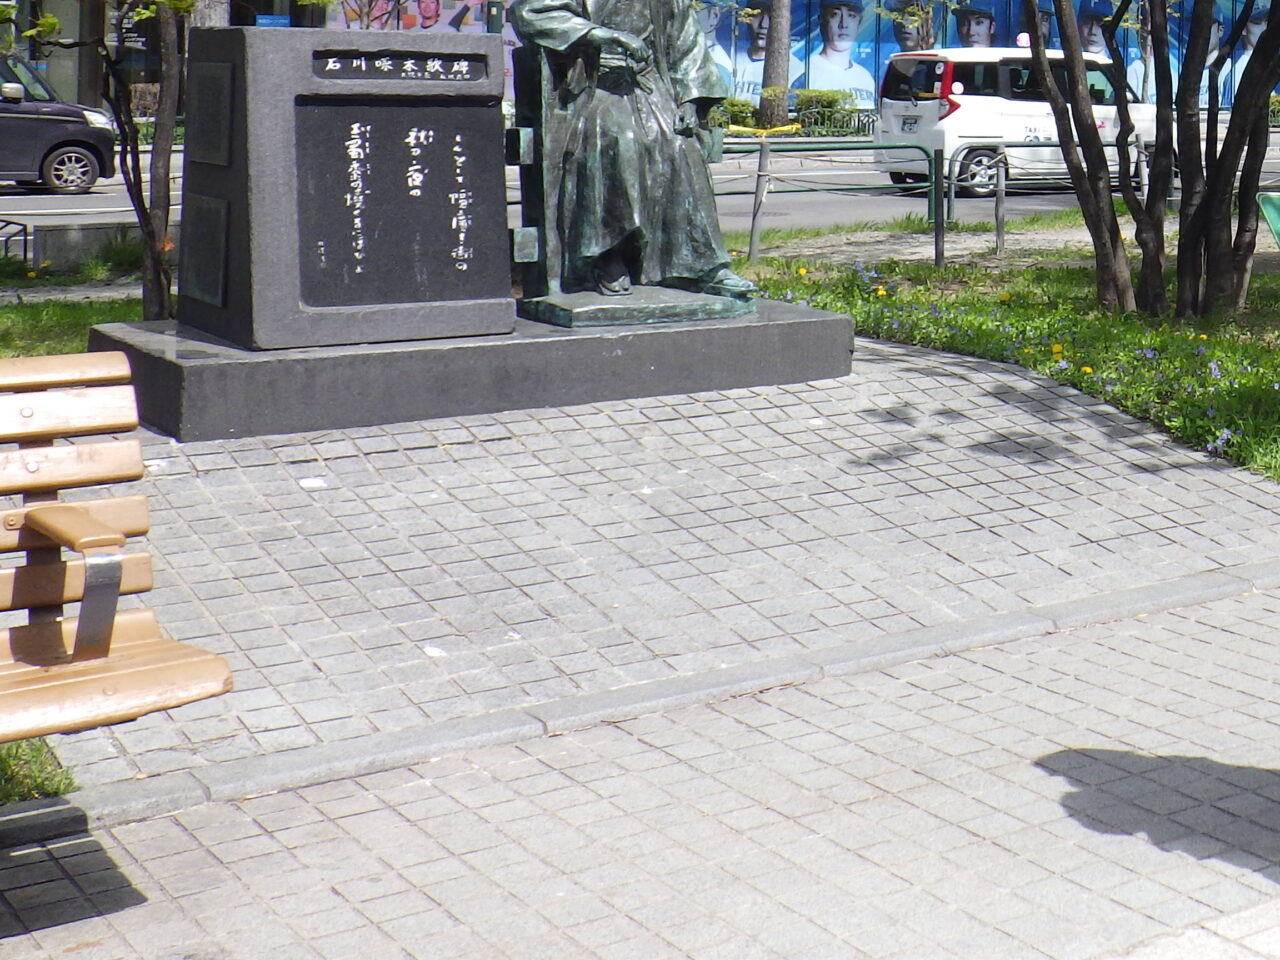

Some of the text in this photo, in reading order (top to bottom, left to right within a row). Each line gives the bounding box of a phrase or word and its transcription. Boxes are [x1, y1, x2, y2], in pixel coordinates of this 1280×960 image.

[325, 56, 470, 74] 石川啄木歌碑
